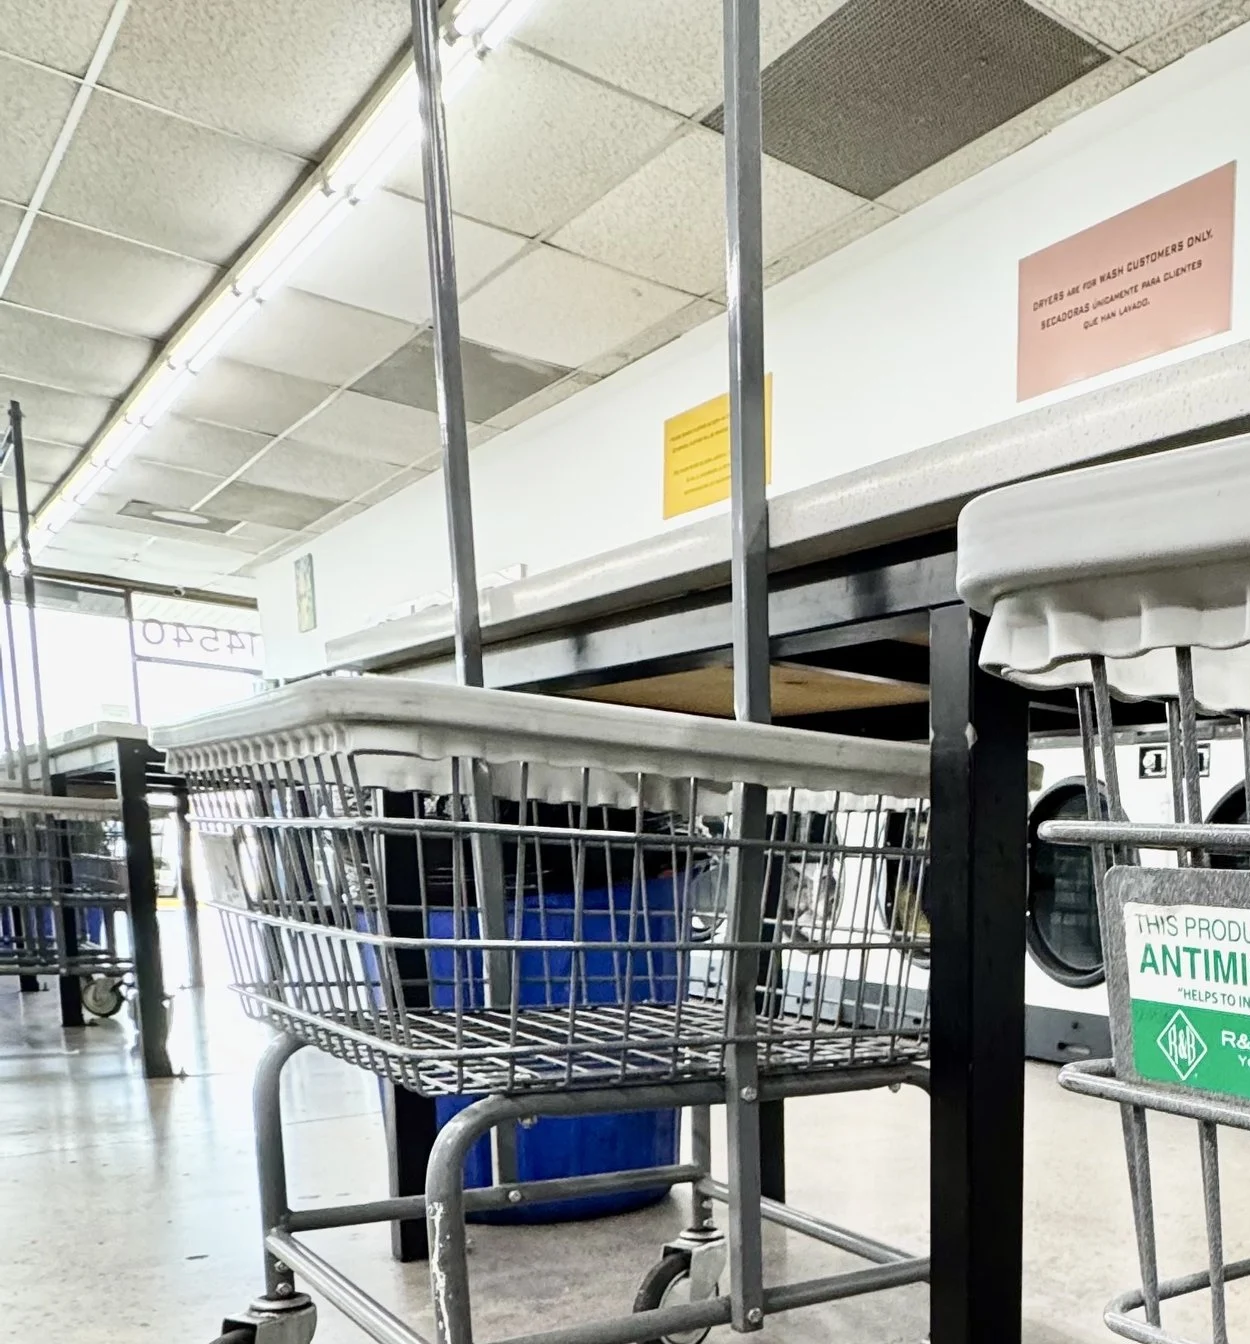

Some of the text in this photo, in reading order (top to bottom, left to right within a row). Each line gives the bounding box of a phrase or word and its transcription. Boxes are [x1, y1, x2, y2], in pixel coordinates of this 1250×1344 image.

[1033, 228, 1214, 311] DRYERS ARE FOR WASH CUSTOMERS ONLY.
[1041, 302, 1090, 330] SECADORAS
[1141, 277, 1161, 290] PARA
[1163, 259, 1203, 282] CLIENTES
[1083, 317, 1098, 330] QUE
[1101, 311, 1116, 323] HAN
[1135, 913, 1178, 937] THIS
[1222, 992, 1236, 1006] TO
[1168, 1023, 1197, 1067] R&B
